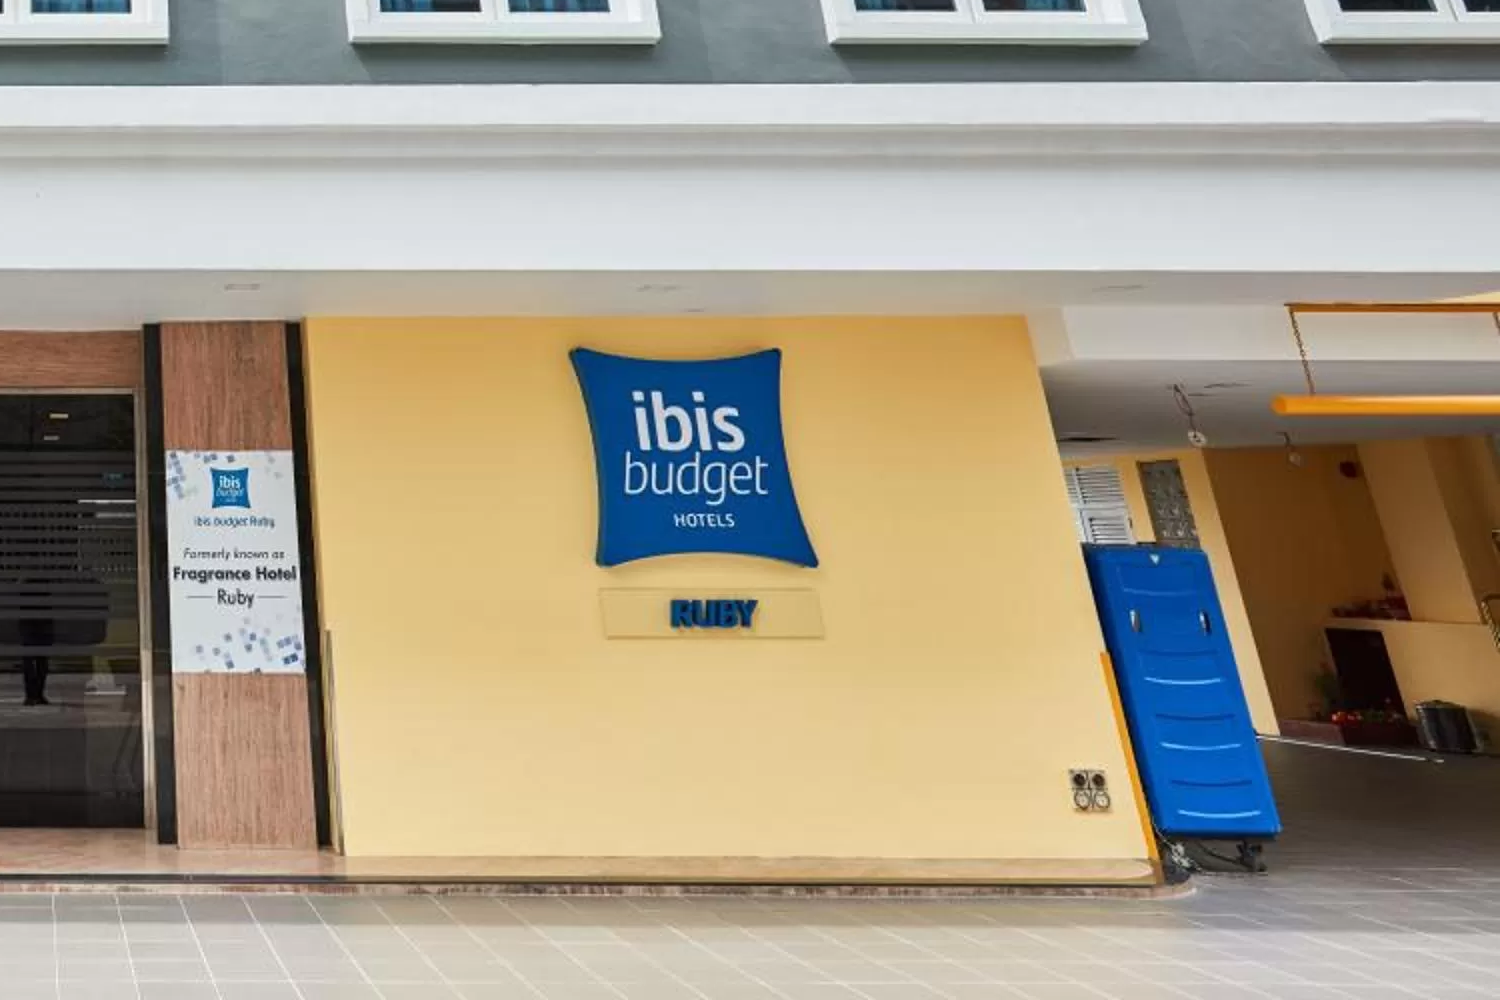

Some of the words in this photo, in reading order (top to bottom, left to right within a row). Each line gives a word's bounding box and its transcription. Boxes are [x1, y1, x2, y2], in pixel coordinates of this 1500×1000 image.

[632, 390, 746, 452] ibis
[219, 475, 241, 489] ibis
[624, 450, 769, 506] budget
[194, 516, 211, 526] ibis
[213, 516, 248, 528] budget
[673, 513, 736, 528] HOTELS
[183, 547, 231, 560] Formerly
[233, 546, 269, 559] known
[271, 551, 285, 559] as
[173, 566, 251, 584] Fragrance
[255, 565, 297, 581] Hotel
[217, 588, 255, 609] Ruby
[669, 599, 758, 628] RUBY
